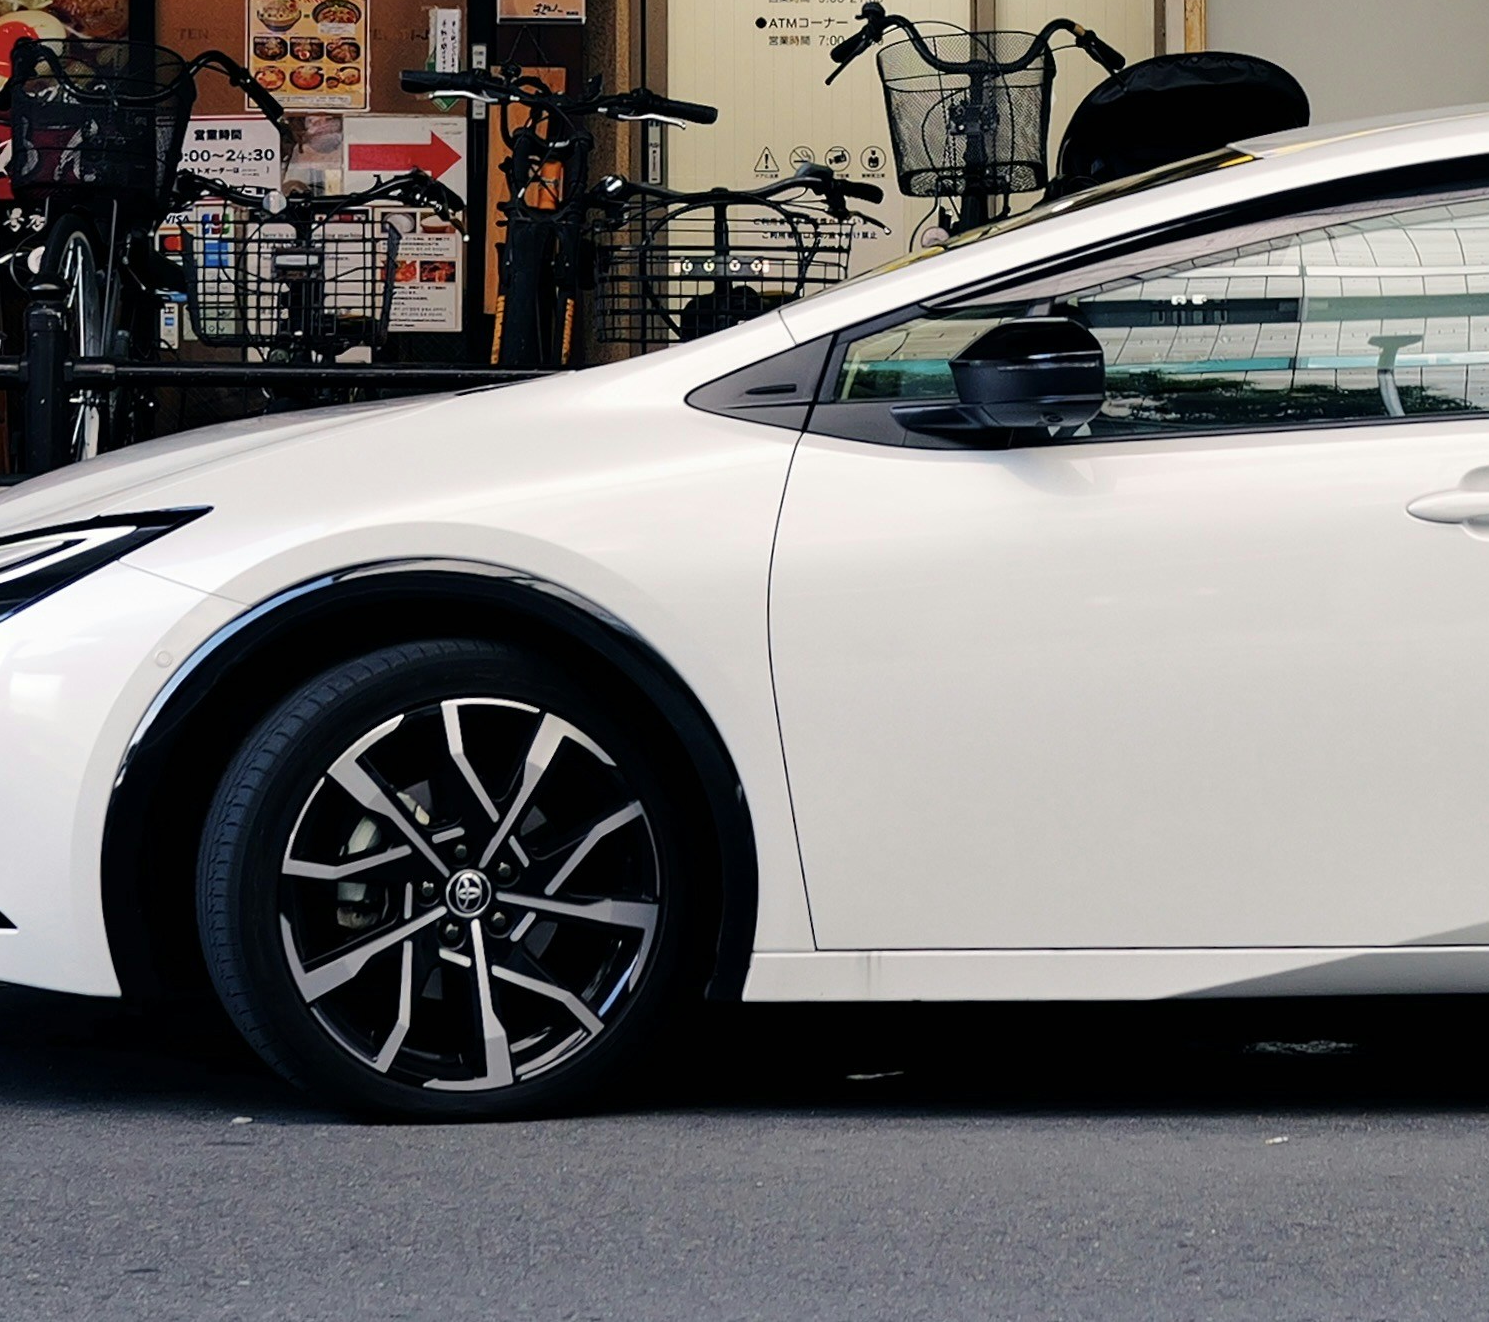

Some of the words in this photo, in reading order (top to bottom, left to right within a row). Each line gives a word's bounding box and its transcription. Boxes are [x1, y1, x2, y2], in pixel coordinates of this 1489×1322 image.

[768, 18, 849, 30] ATMコーナー
[768, 36, 810, 47] 営業時間
[194, 129, 243, 141] 営業時間
